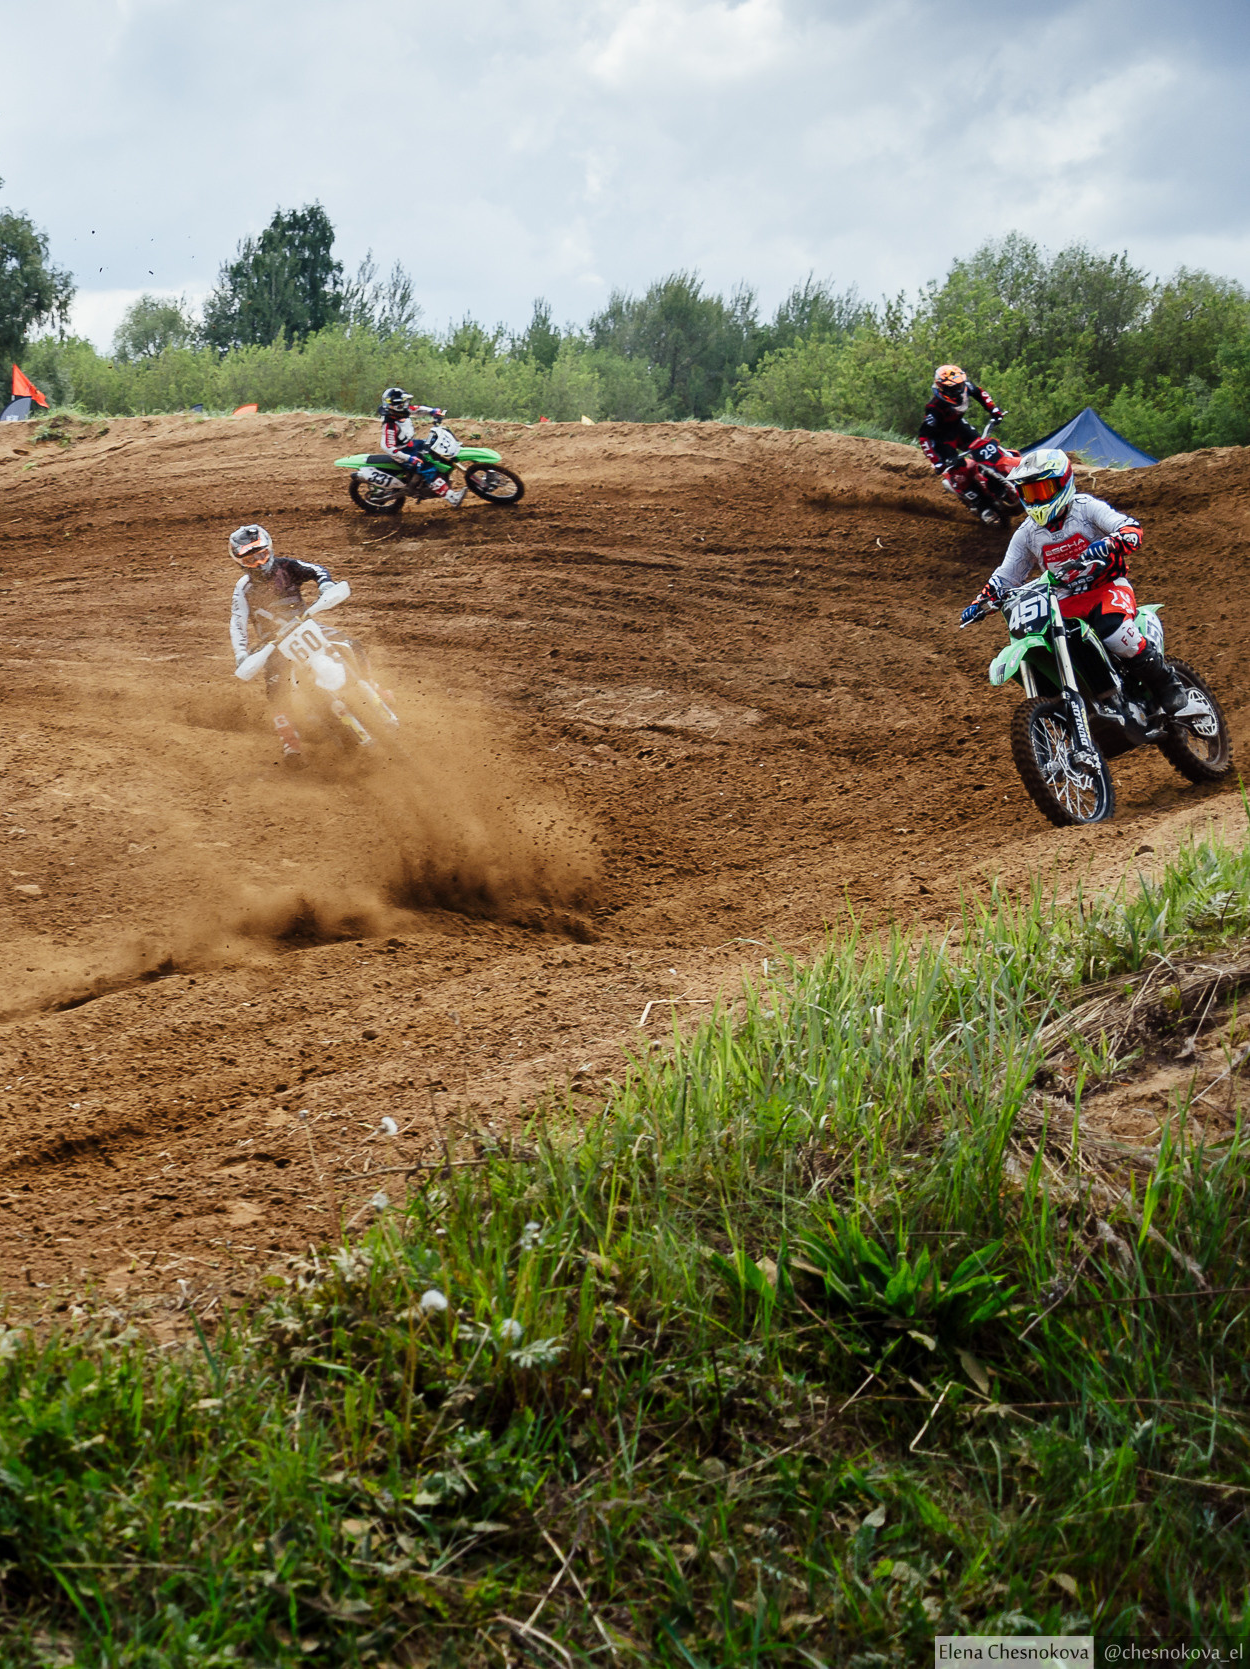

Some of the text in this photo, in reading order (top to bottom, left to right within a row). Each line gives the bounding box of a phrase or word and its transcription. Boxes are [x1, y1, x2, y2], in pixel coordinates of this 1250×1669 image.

[980, 443, 997, 460] 29
[368, 471, 393, 487] 331
[1009, 592, 1049, 631] 451
[289, 629, 323, 663] 60
[1070, 701, 1090, 747] DUNLOP
